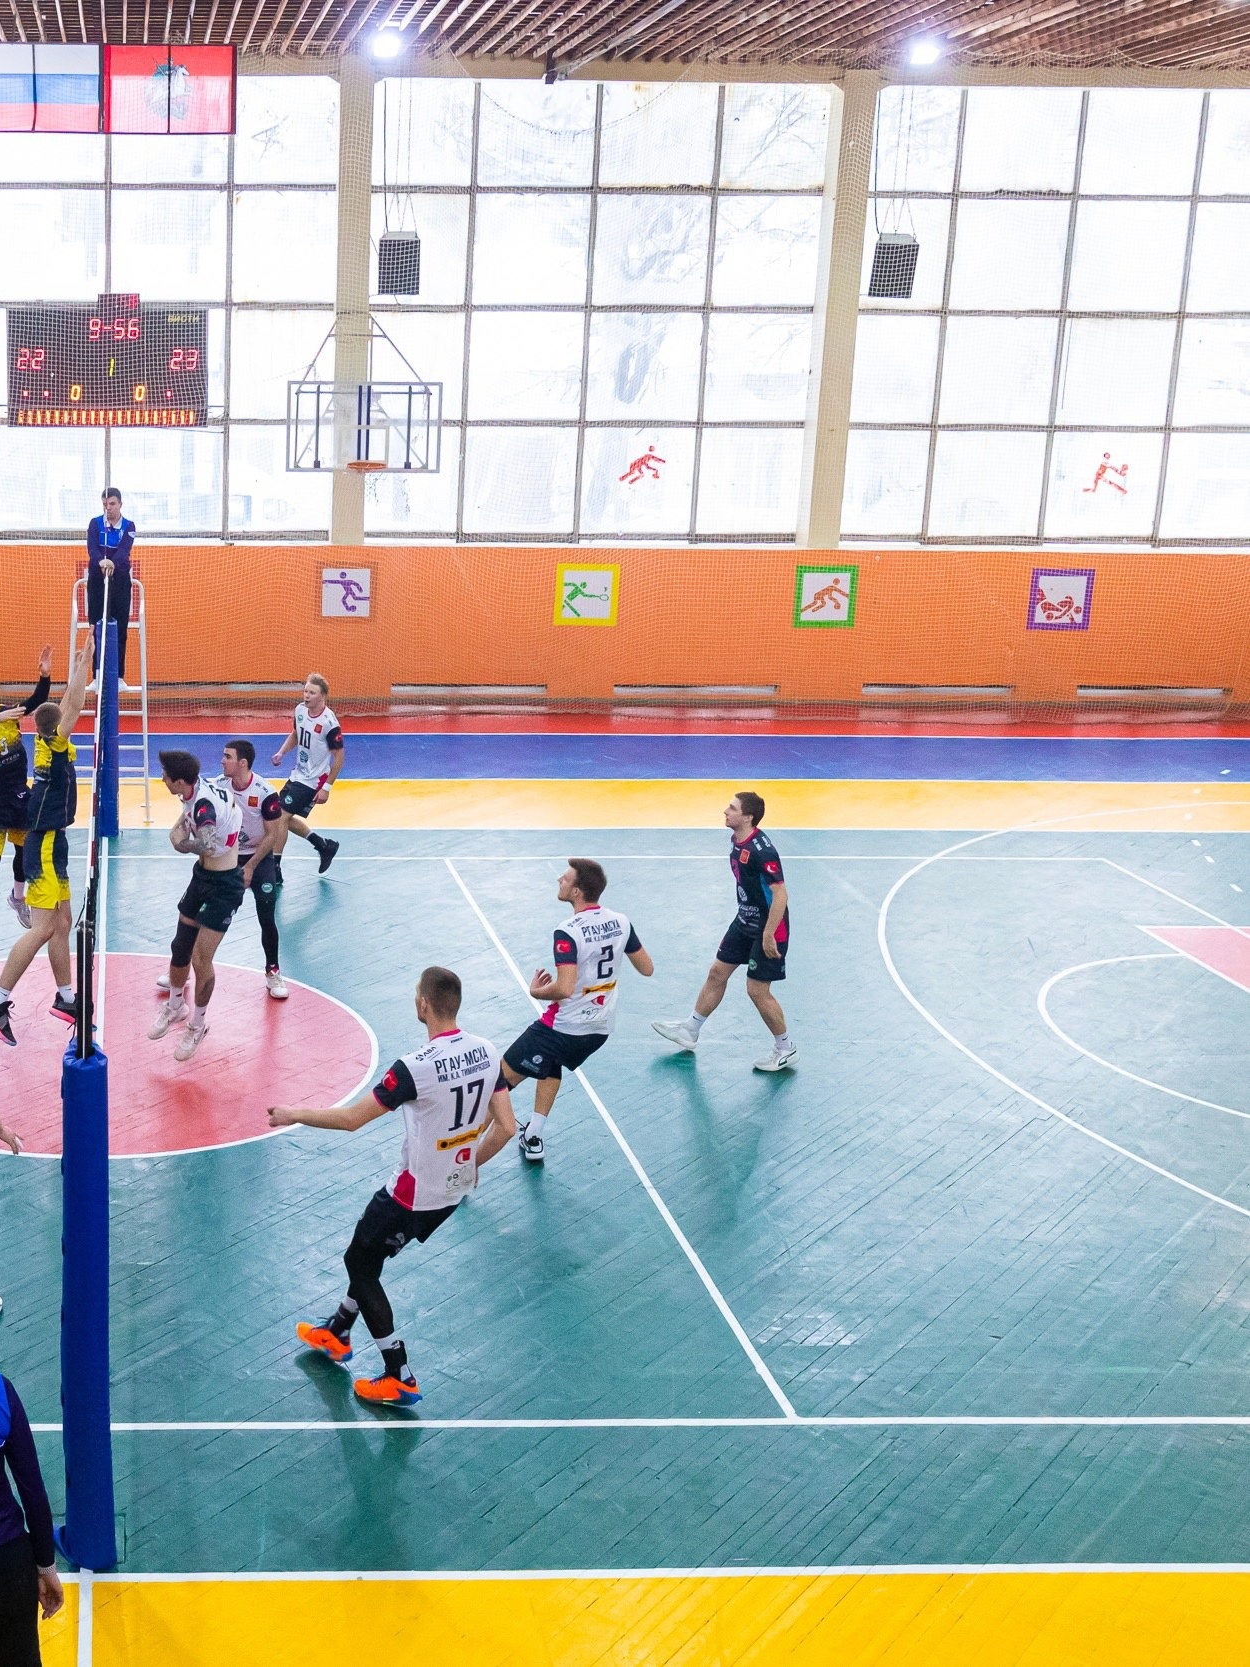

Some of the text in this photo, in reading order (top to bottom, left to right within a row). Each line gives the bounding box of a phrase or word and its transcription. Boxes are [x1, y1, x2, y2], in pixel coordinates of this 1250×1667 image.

[89, 317, 140, 340] 9-56
[16, 348, 45, 370] 22
[170, 348, 198, 370] 23
[70, 384, 82, 401] 0
[134, 384, 147, 401] 0
[299, 726, 311, 750] 10
[597, 944, 614, 979] 2
[434, 1046, 489, 1074] РГАУ-МСХА
[448, 1078, 485, 1132] 17
